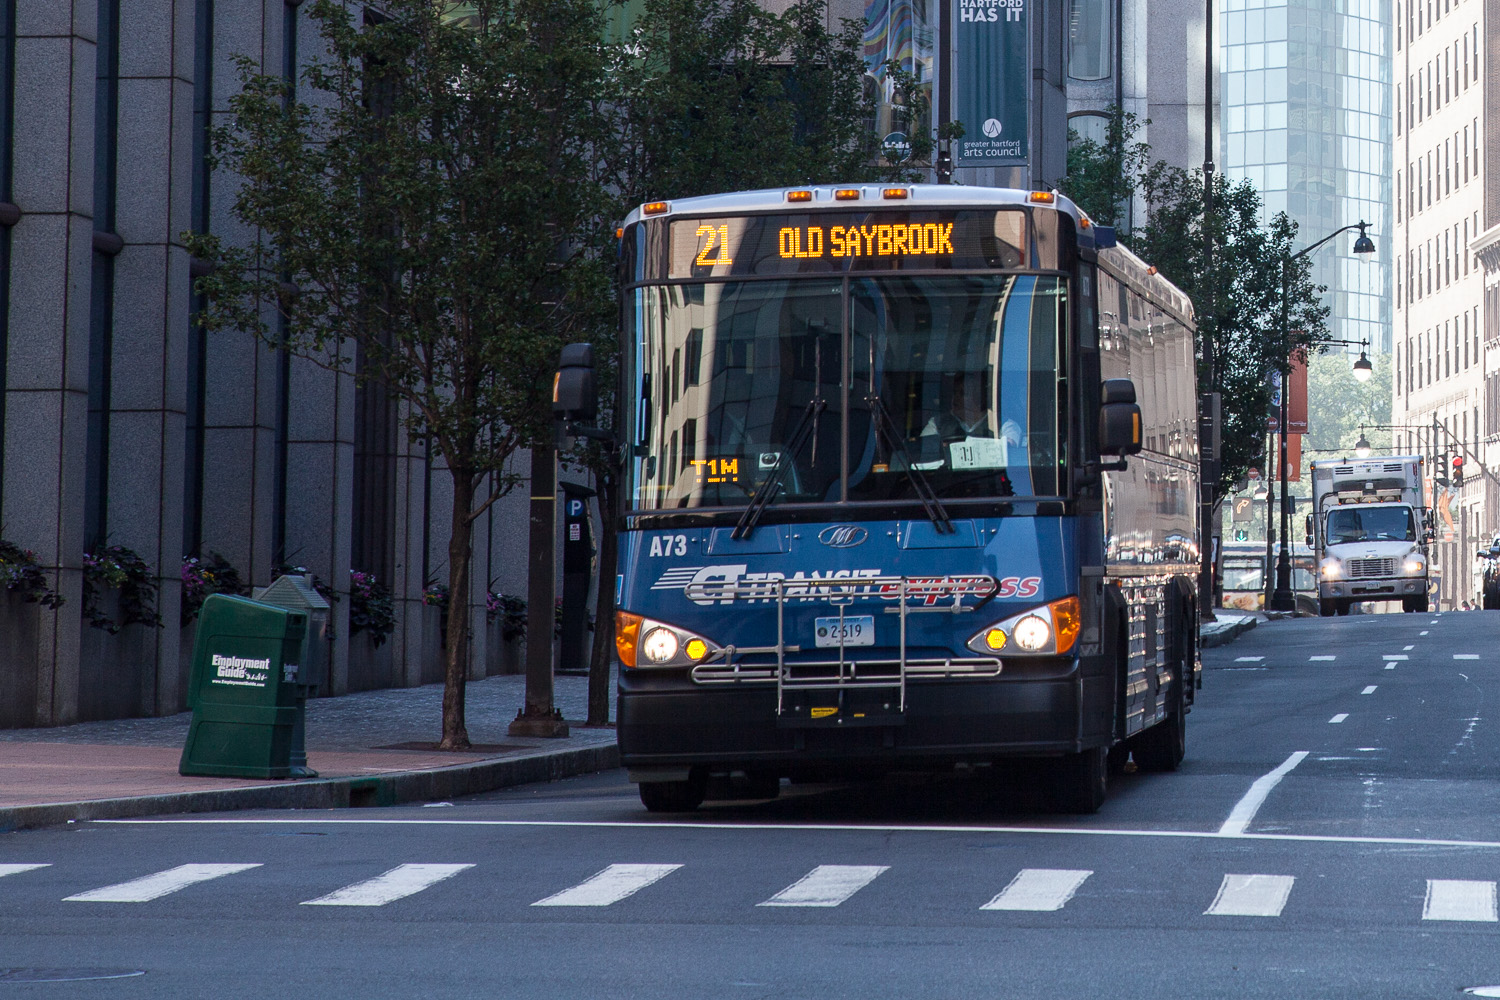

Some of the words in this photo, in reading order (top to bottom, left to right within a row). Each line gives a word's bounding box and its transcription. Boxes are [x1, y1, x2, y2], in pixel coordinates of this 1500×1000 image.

[960, 0, 1024, 8] HARTFORD
[960, 8, 999, 22] HAS
[1006, 8, 1023, 22] IT
[964, 141, 990, 149] greater
[991, 140, 1020, 148] hartford
[964, 148, 983, 157] arts
[985, 147, 1021, 156] council
[695, 224, 733, 266] 21
[779, 227, 824, 258] OLD
[830, 222, 954, 257] SAYBROOK
[571, 500, 582, 516] P
[649, 534, 687, 557] A73
[211, 654, 270, 670] Employment
[217, 665, 246, 679] Guide
